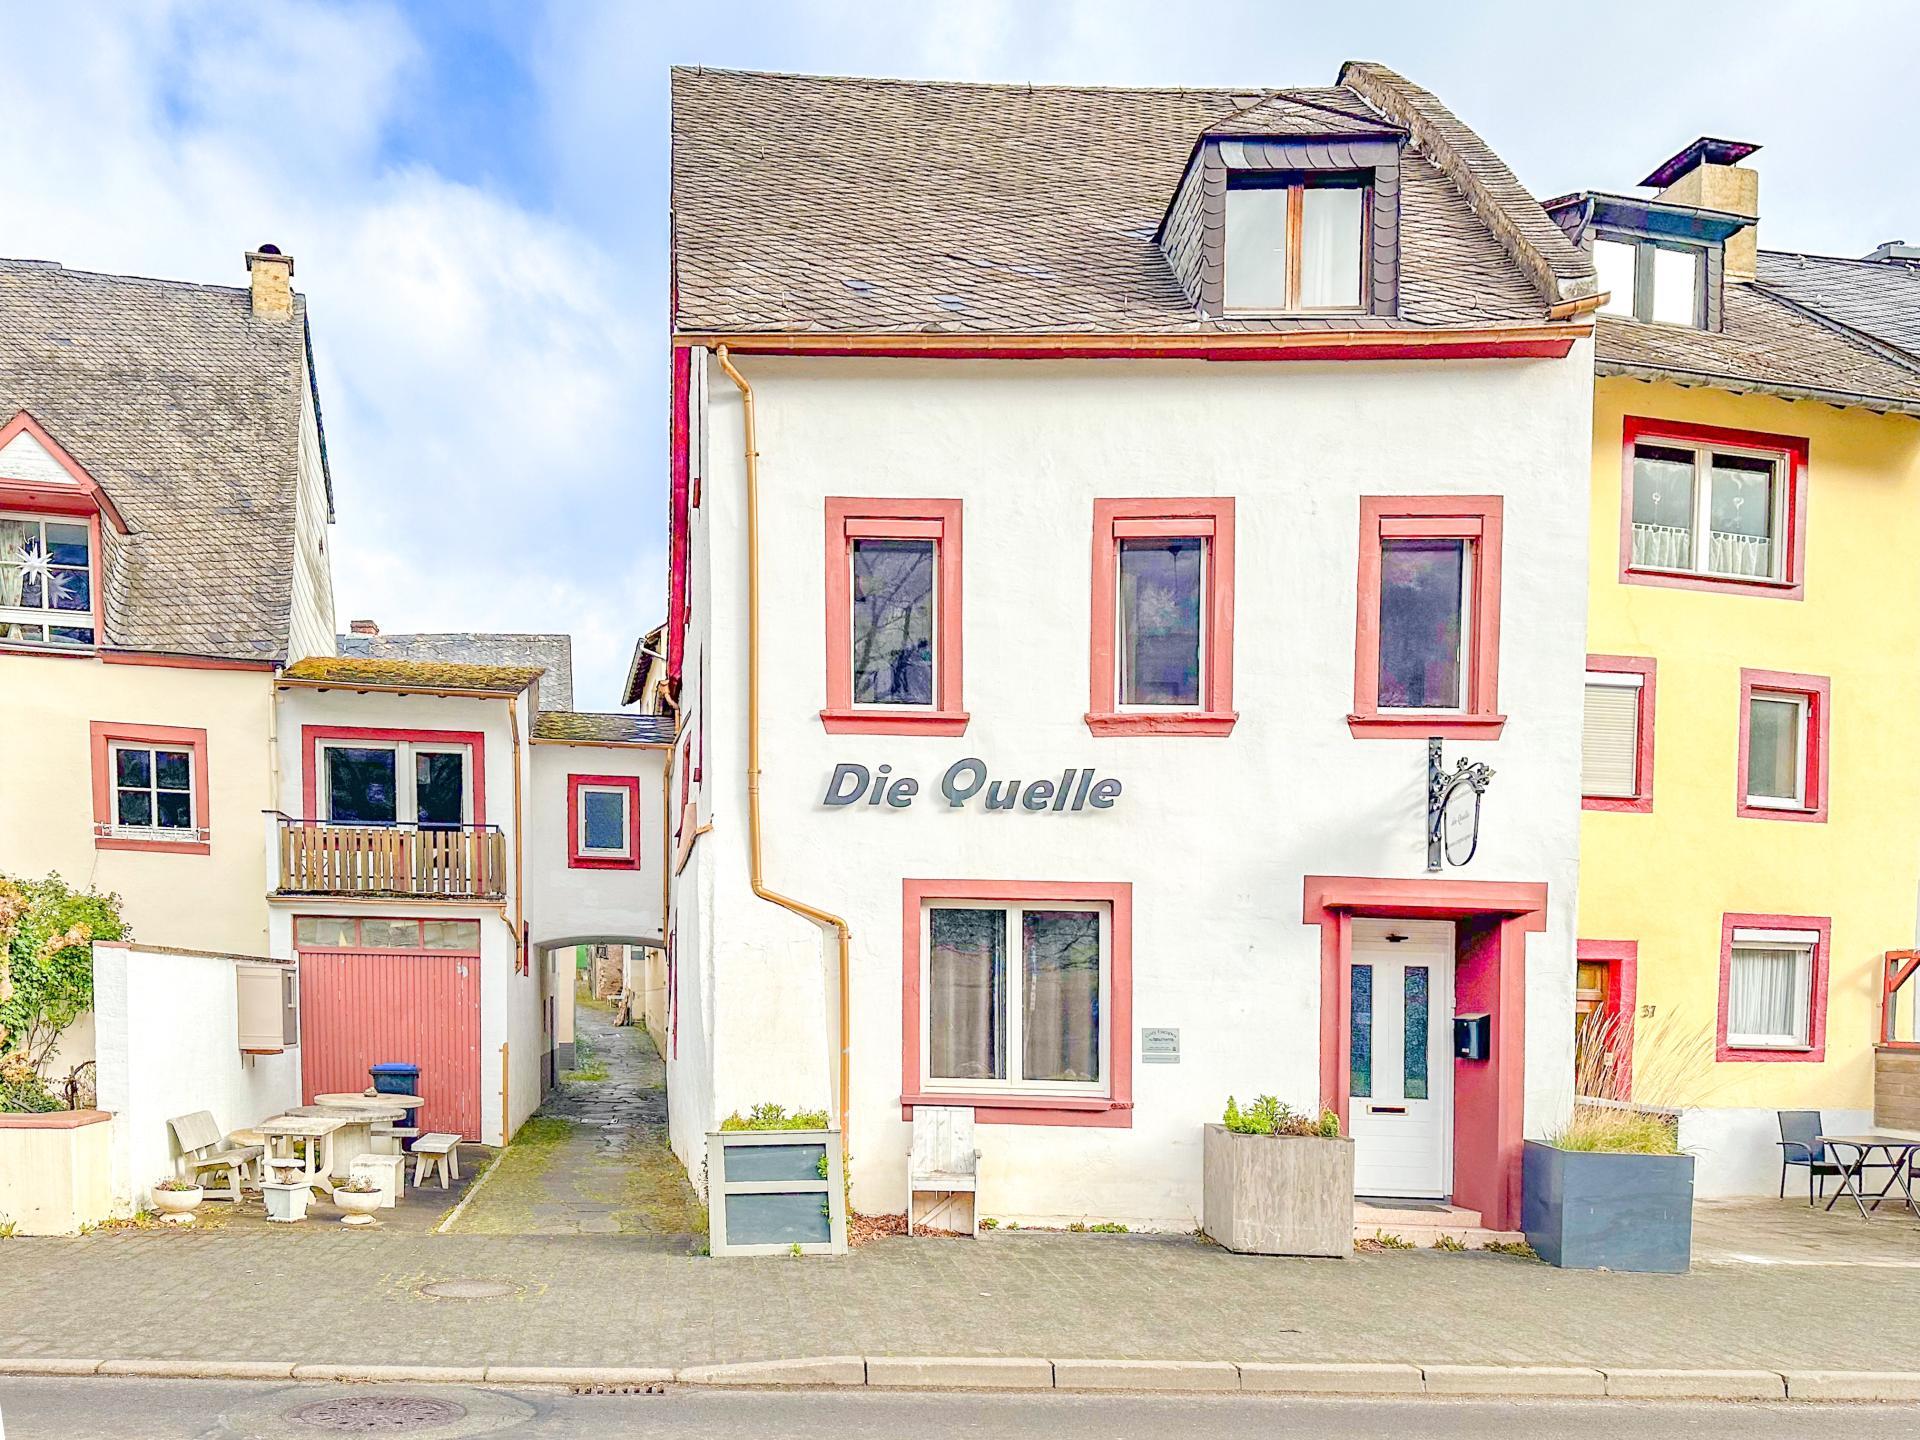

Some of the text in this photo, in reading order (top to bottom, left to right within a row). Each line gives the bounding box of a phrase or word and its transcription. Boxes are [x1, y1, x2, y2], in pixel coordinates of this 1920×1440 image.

[823, 757, 1123, 812] Die Quelle
[1640, 1004, 1656, 1019] 37
